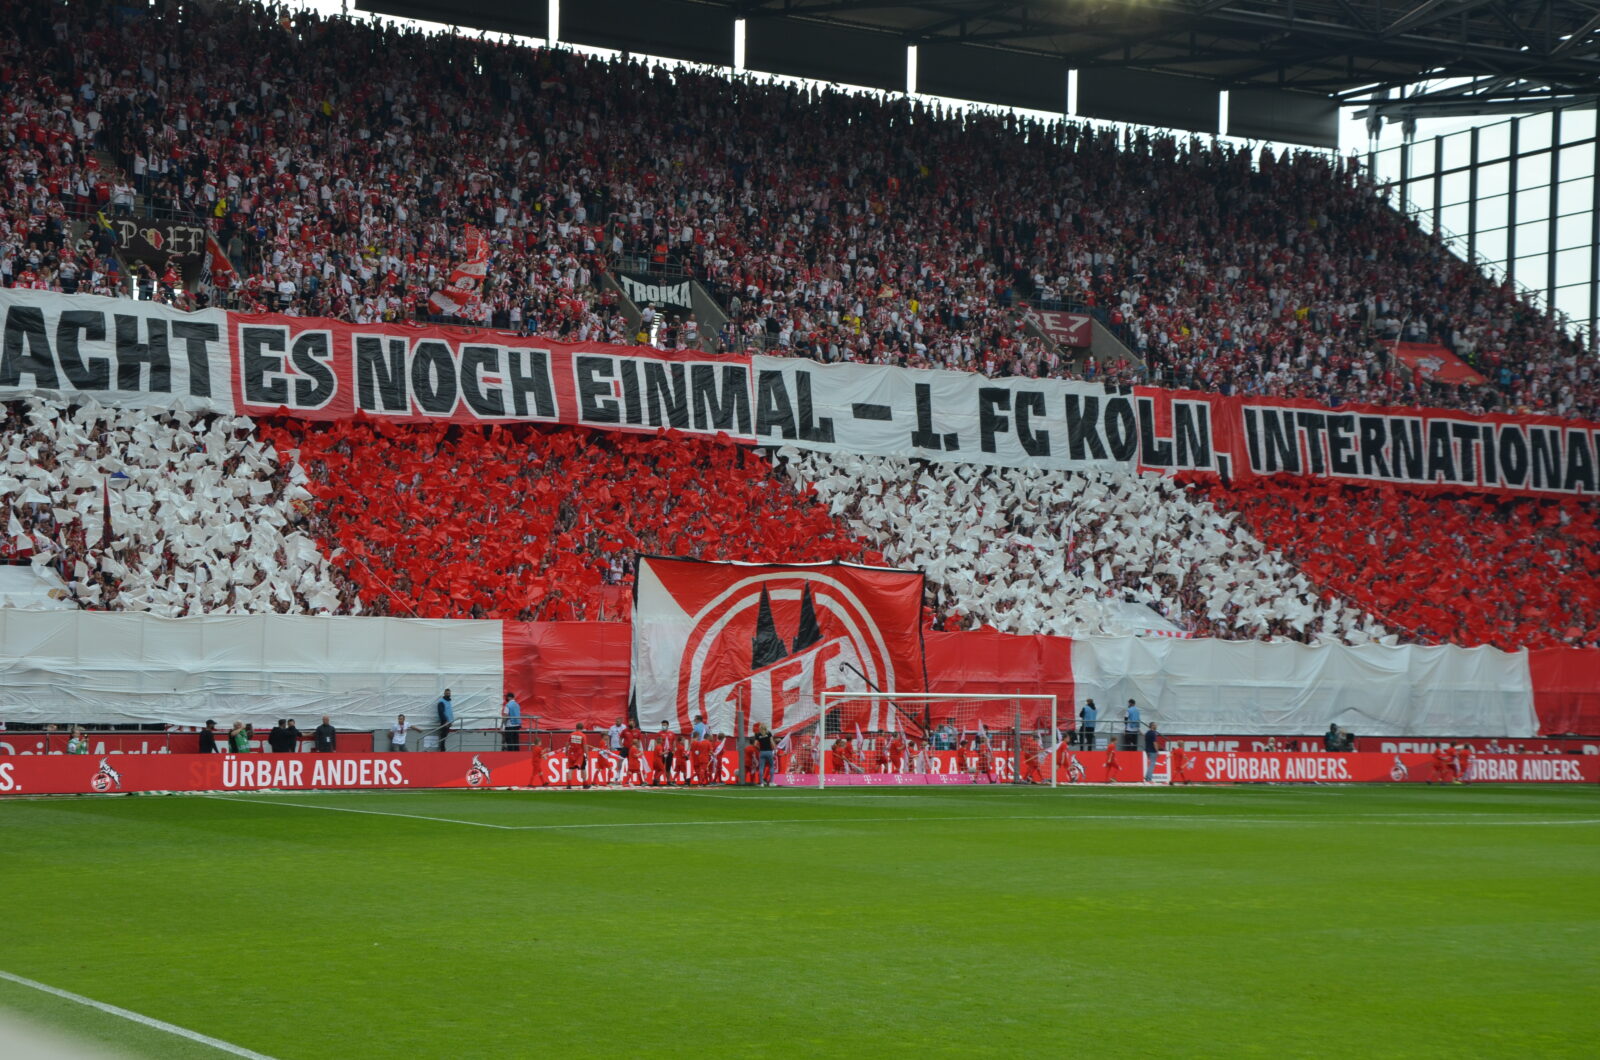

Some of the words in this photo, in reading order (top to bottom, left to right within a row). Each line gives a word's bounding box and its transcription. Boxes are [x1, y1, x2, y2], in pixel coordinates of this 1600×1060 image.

[620, 274, 692, 309] TROIKA
[0, 305, 219, 397] ACHT
[242, 327, 335, 408] ES
[355, 336, 556, 418] NOCH
[576, 355, 836, 444] EINMAL
[911, 383, 960, 452] 1.
[978, 387, 1051, 457] FC
[1243, 407, 1600, 492] INTERNATIONA
[311, 758, 410, 786] ANDERS.
[1205, 753, 1281, 779] SPÜRBAR
[1285, 757, 1352, 780] ANDERS.
[1522, 759, 1585, 781] ANDERS.
